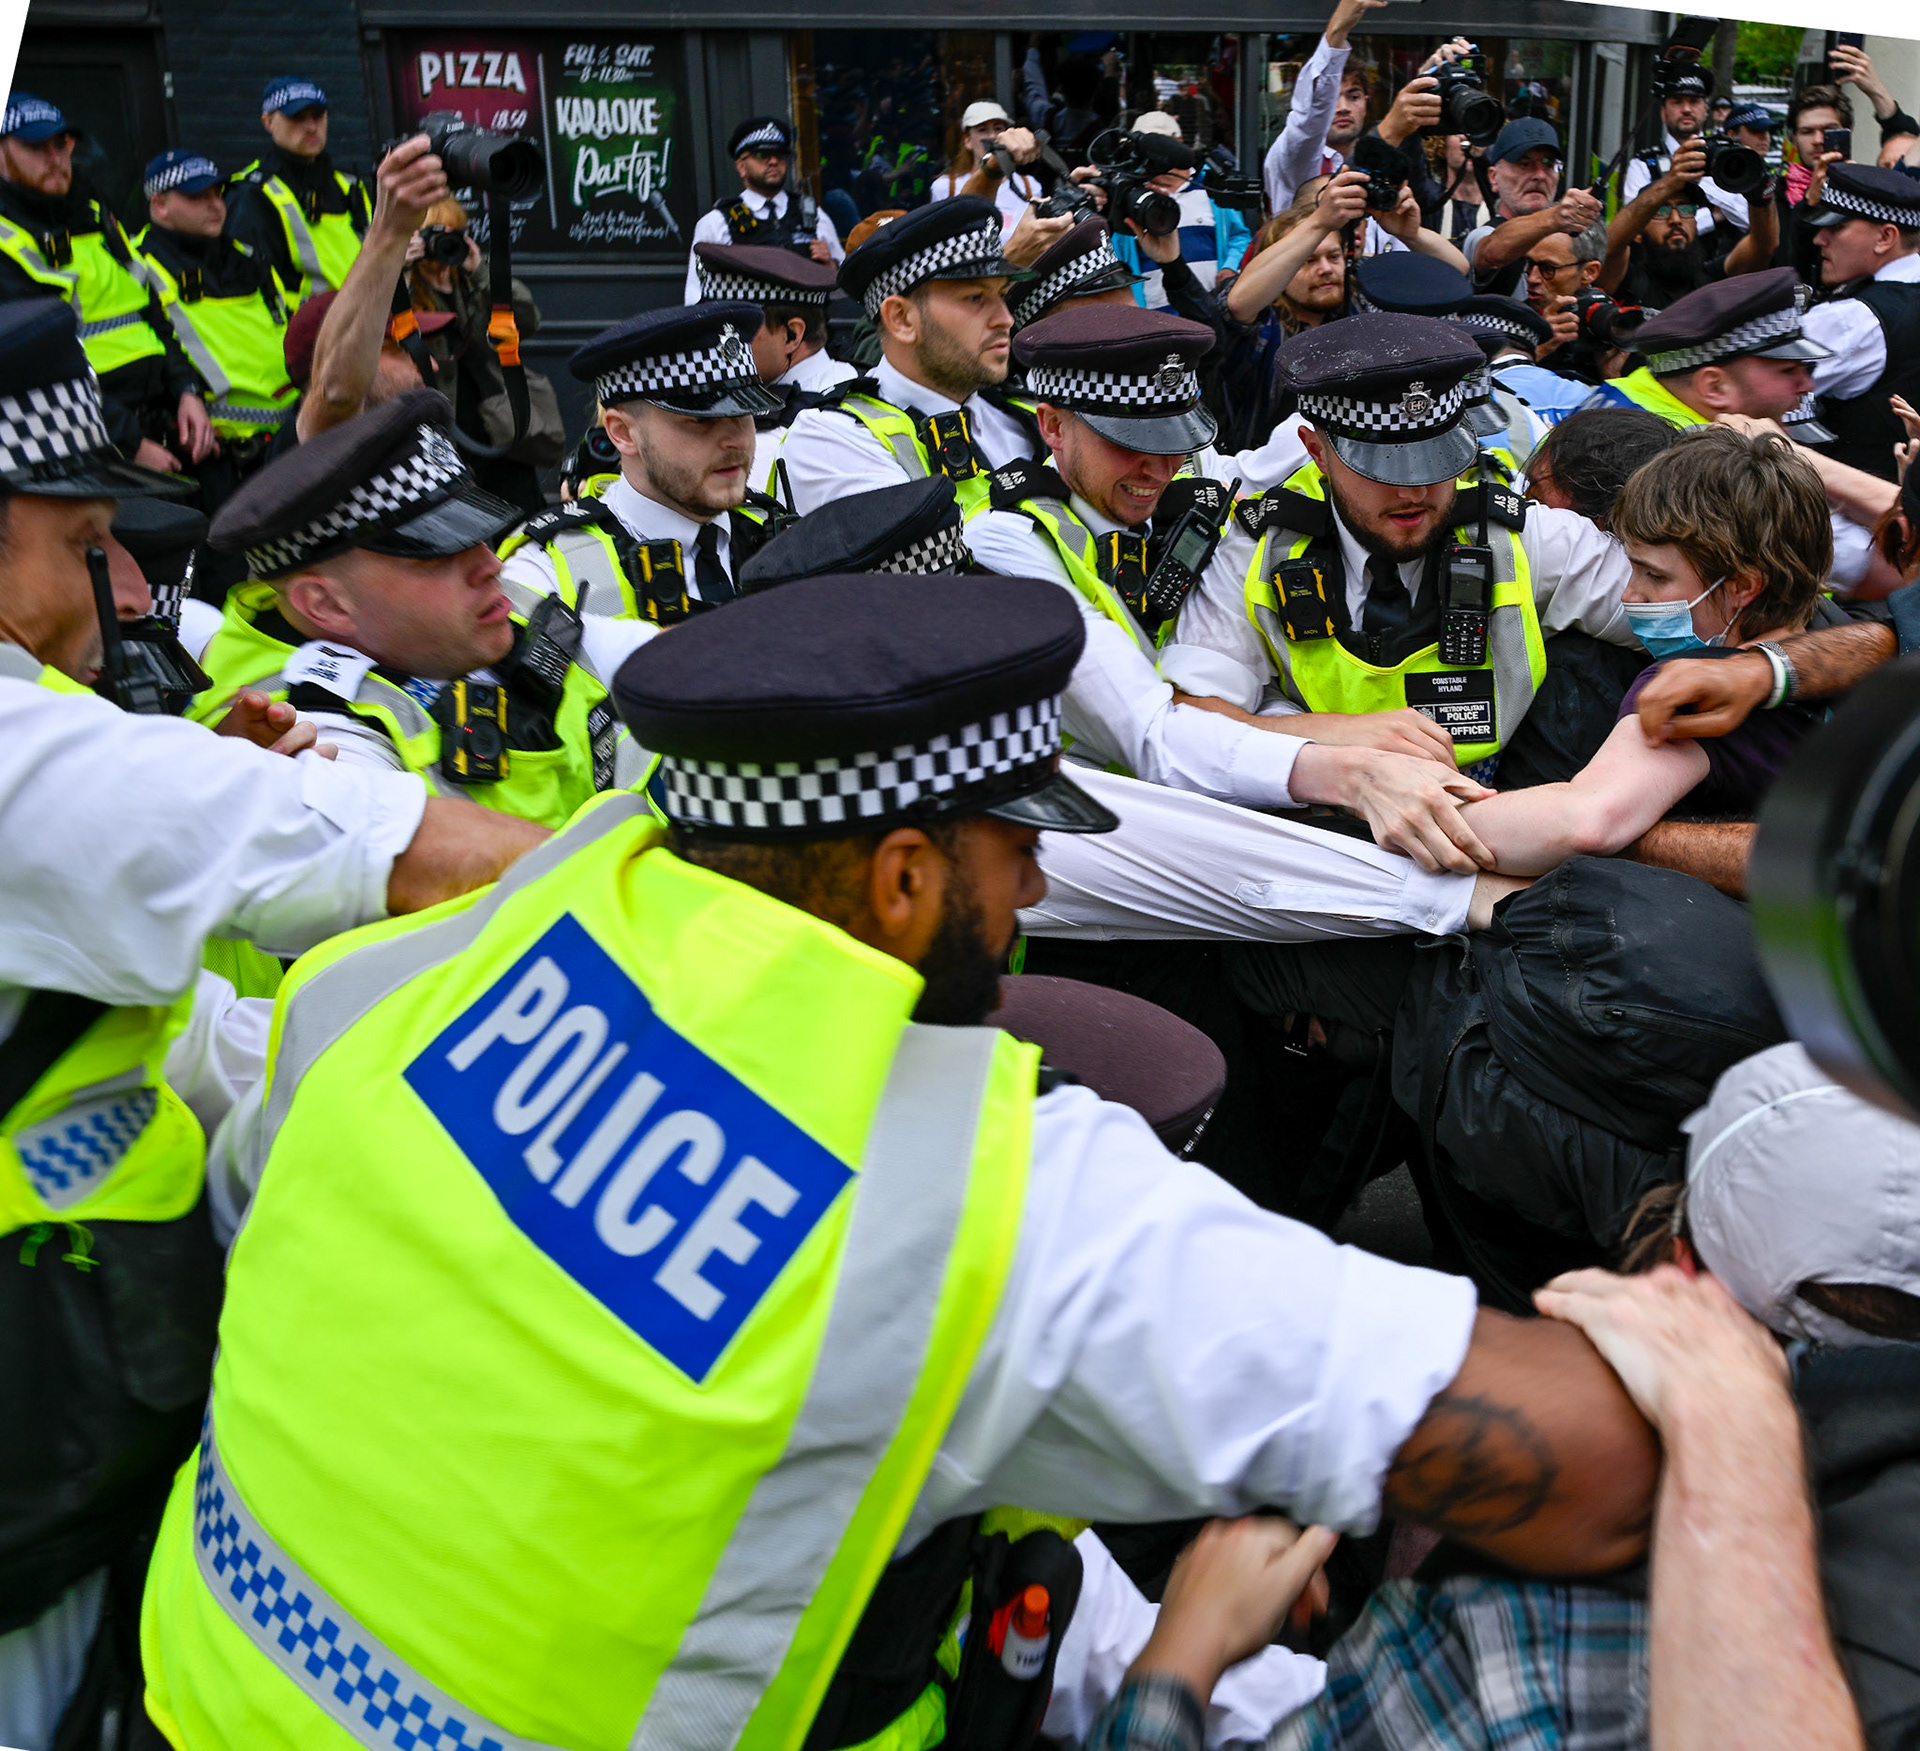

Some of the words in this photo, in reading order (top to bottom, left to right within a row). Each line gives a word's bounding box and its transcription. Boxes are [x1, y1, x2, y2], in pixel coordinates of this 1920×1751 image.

[418, 51, 527, 96] PIZZA
[556, 97, 662, 140] KARAOKE
[575, 138, 671, 206] Party!
[1194, 489, 1206, 505] AS
[1205, 486, 1220, 508] 2301
[1494, 494, 1507, 509] AS
[1266, 499, 1279, 512] AS
[1432, 676, 1467, 685] CONSTABLE
[1440, 704, 1484, 713] METROPOLITAN
[1447, 712, 1478, 722] POLICE
[1451, 726, 1491, 735] OFFICER
[445, 955, 802, 1321] POLICE
